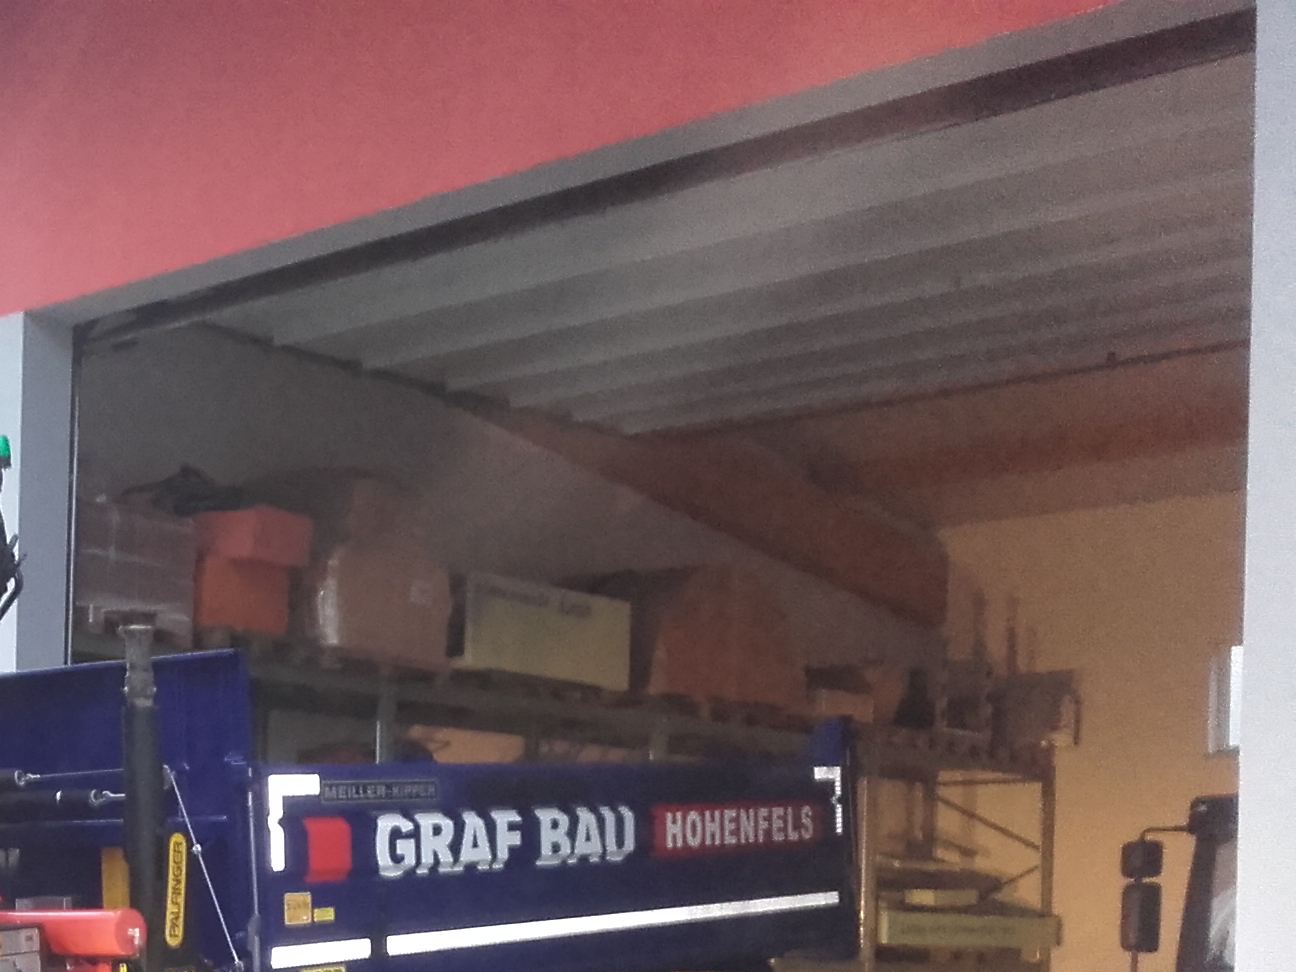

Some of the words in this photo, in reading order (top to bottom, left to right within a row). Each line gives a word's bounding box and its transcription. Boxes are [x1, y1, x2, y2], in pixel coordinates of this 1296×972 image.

[375, 808, 522, 878] GRAF
[534, 804, 635, 865] BAU
[665, 805, 813, 849] HOHENFELS
[168, 840, 182, 938] PALFINGER
